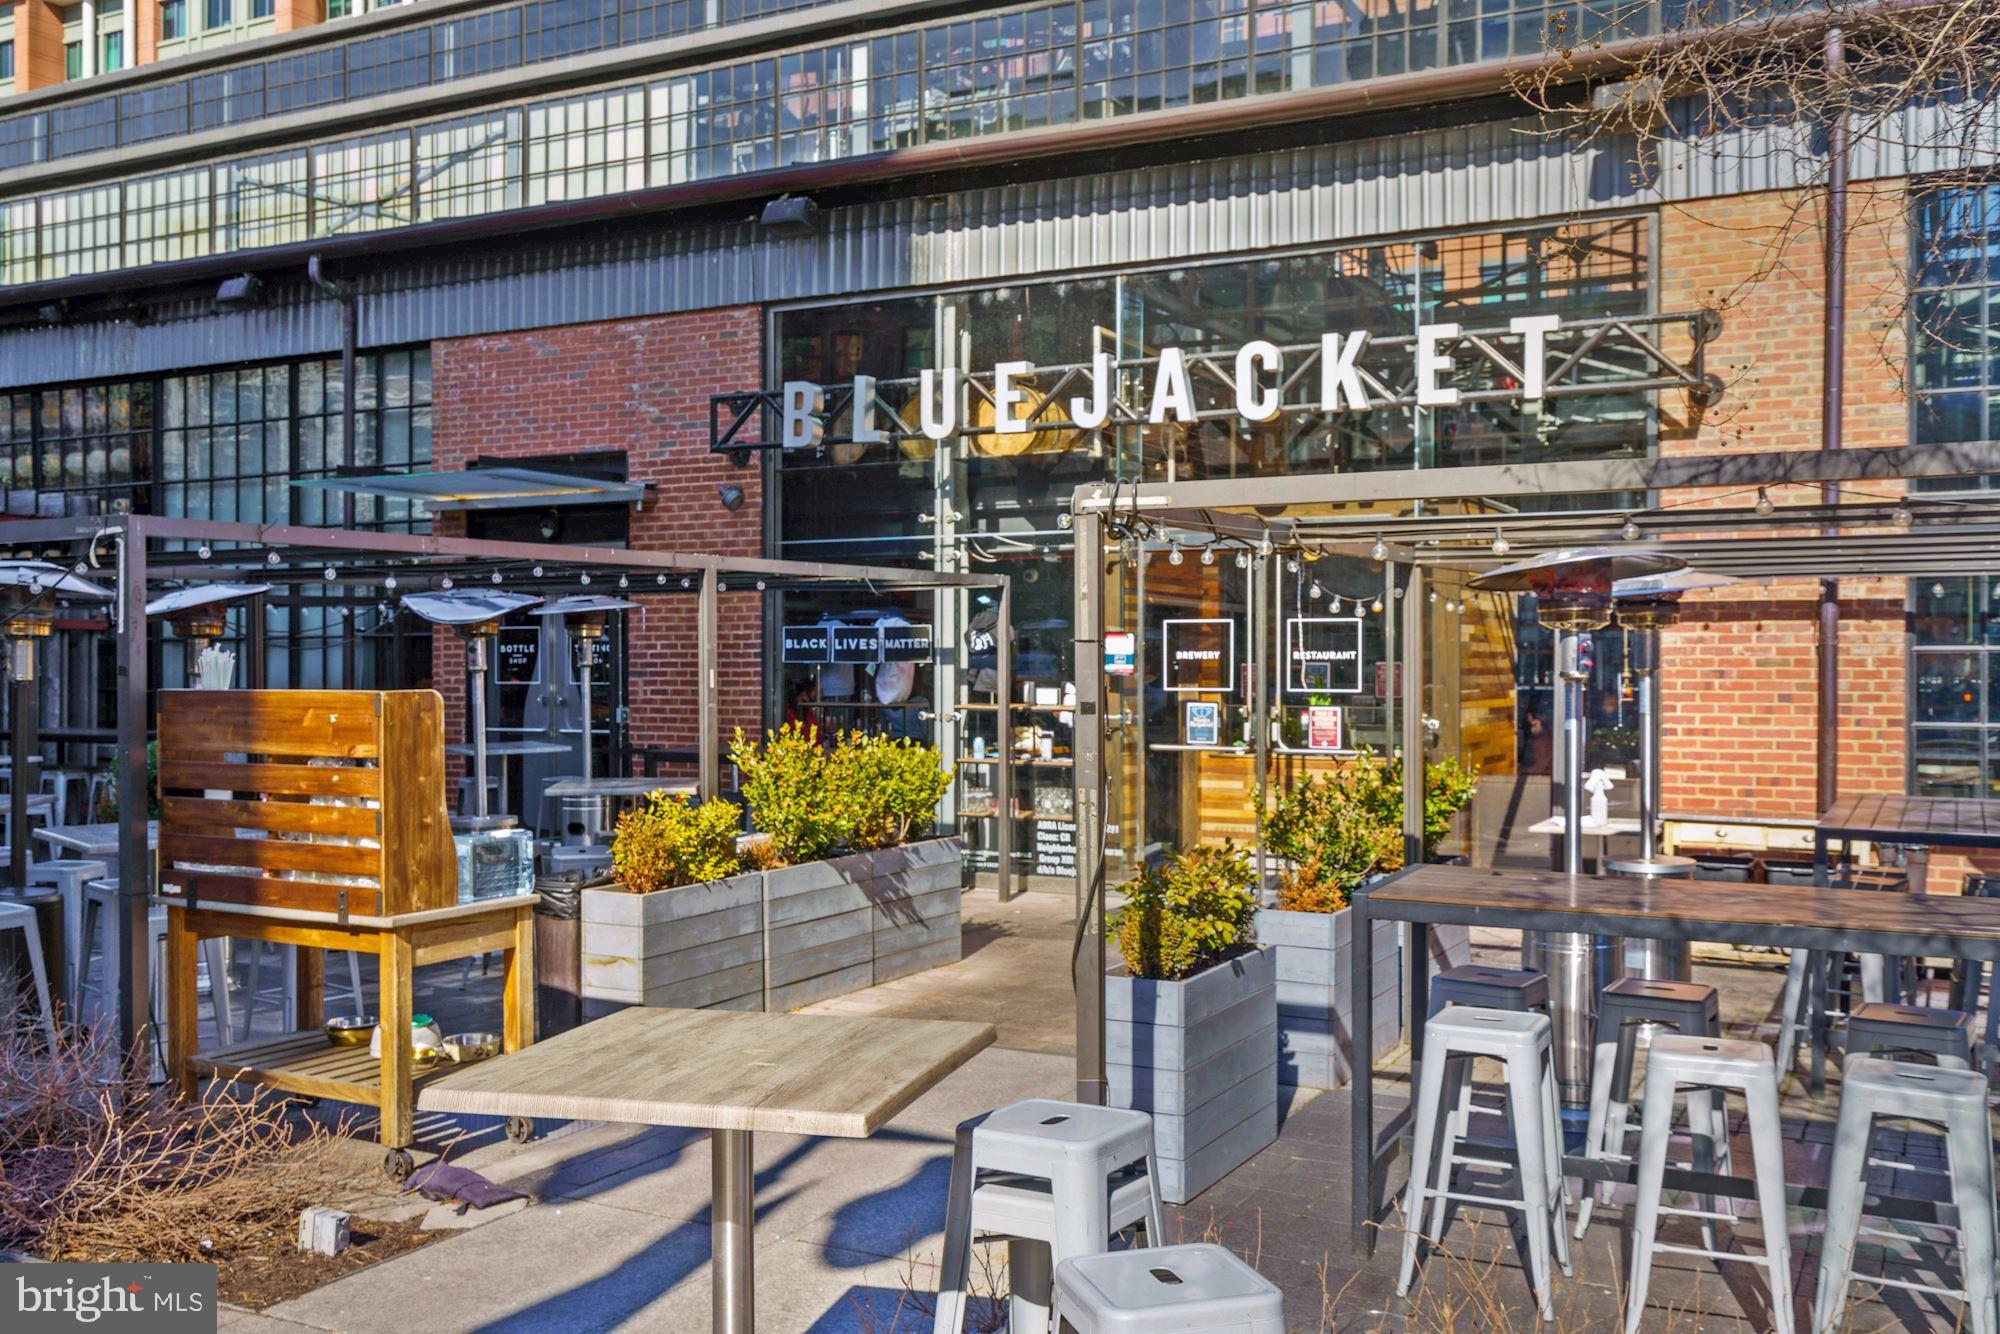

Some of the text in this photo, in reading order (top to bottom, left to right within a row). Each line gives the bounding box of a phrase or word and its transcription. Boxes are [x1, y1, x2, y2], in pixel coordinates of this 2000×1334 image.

[783, 315, 1561, 449] BLUEJACKET
[500, 644, 535, 653] BOTTLE
[785, 638, 929, 650] BLACK LIVES MATTER
[1176, 651, 1221, 660] BREWERY
[1292, 651, 1357, 660] RESTAURANT
